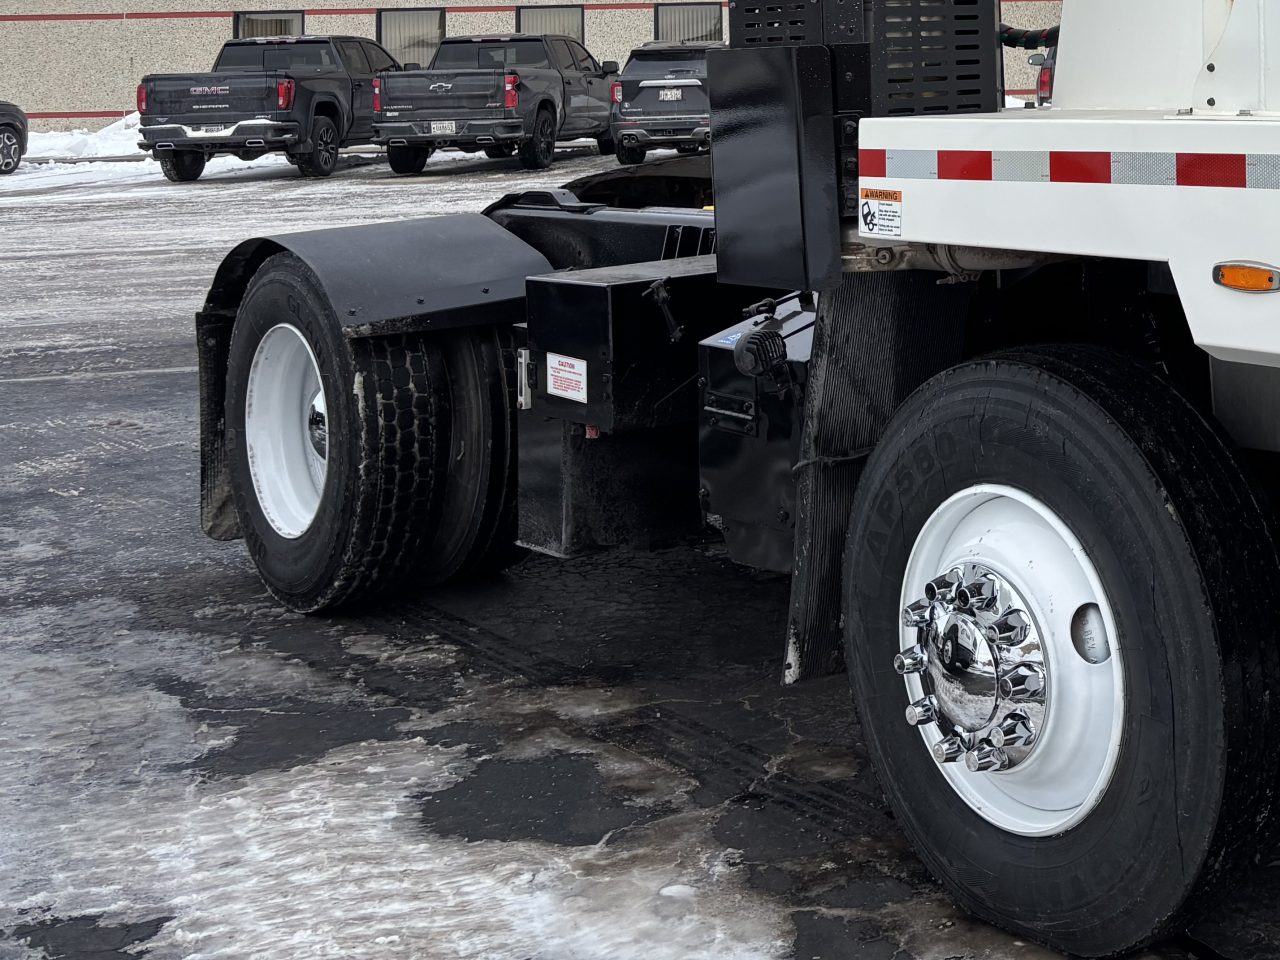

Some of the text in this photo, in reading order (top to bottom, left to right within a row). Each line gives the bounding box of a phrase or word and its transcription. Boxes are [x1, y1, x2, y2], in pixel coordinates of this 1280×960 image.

[190, 86, 230, 95] GMC
[870, 190, 898, 201] WARNING
[558, 360, 576, 369] CAUTION
